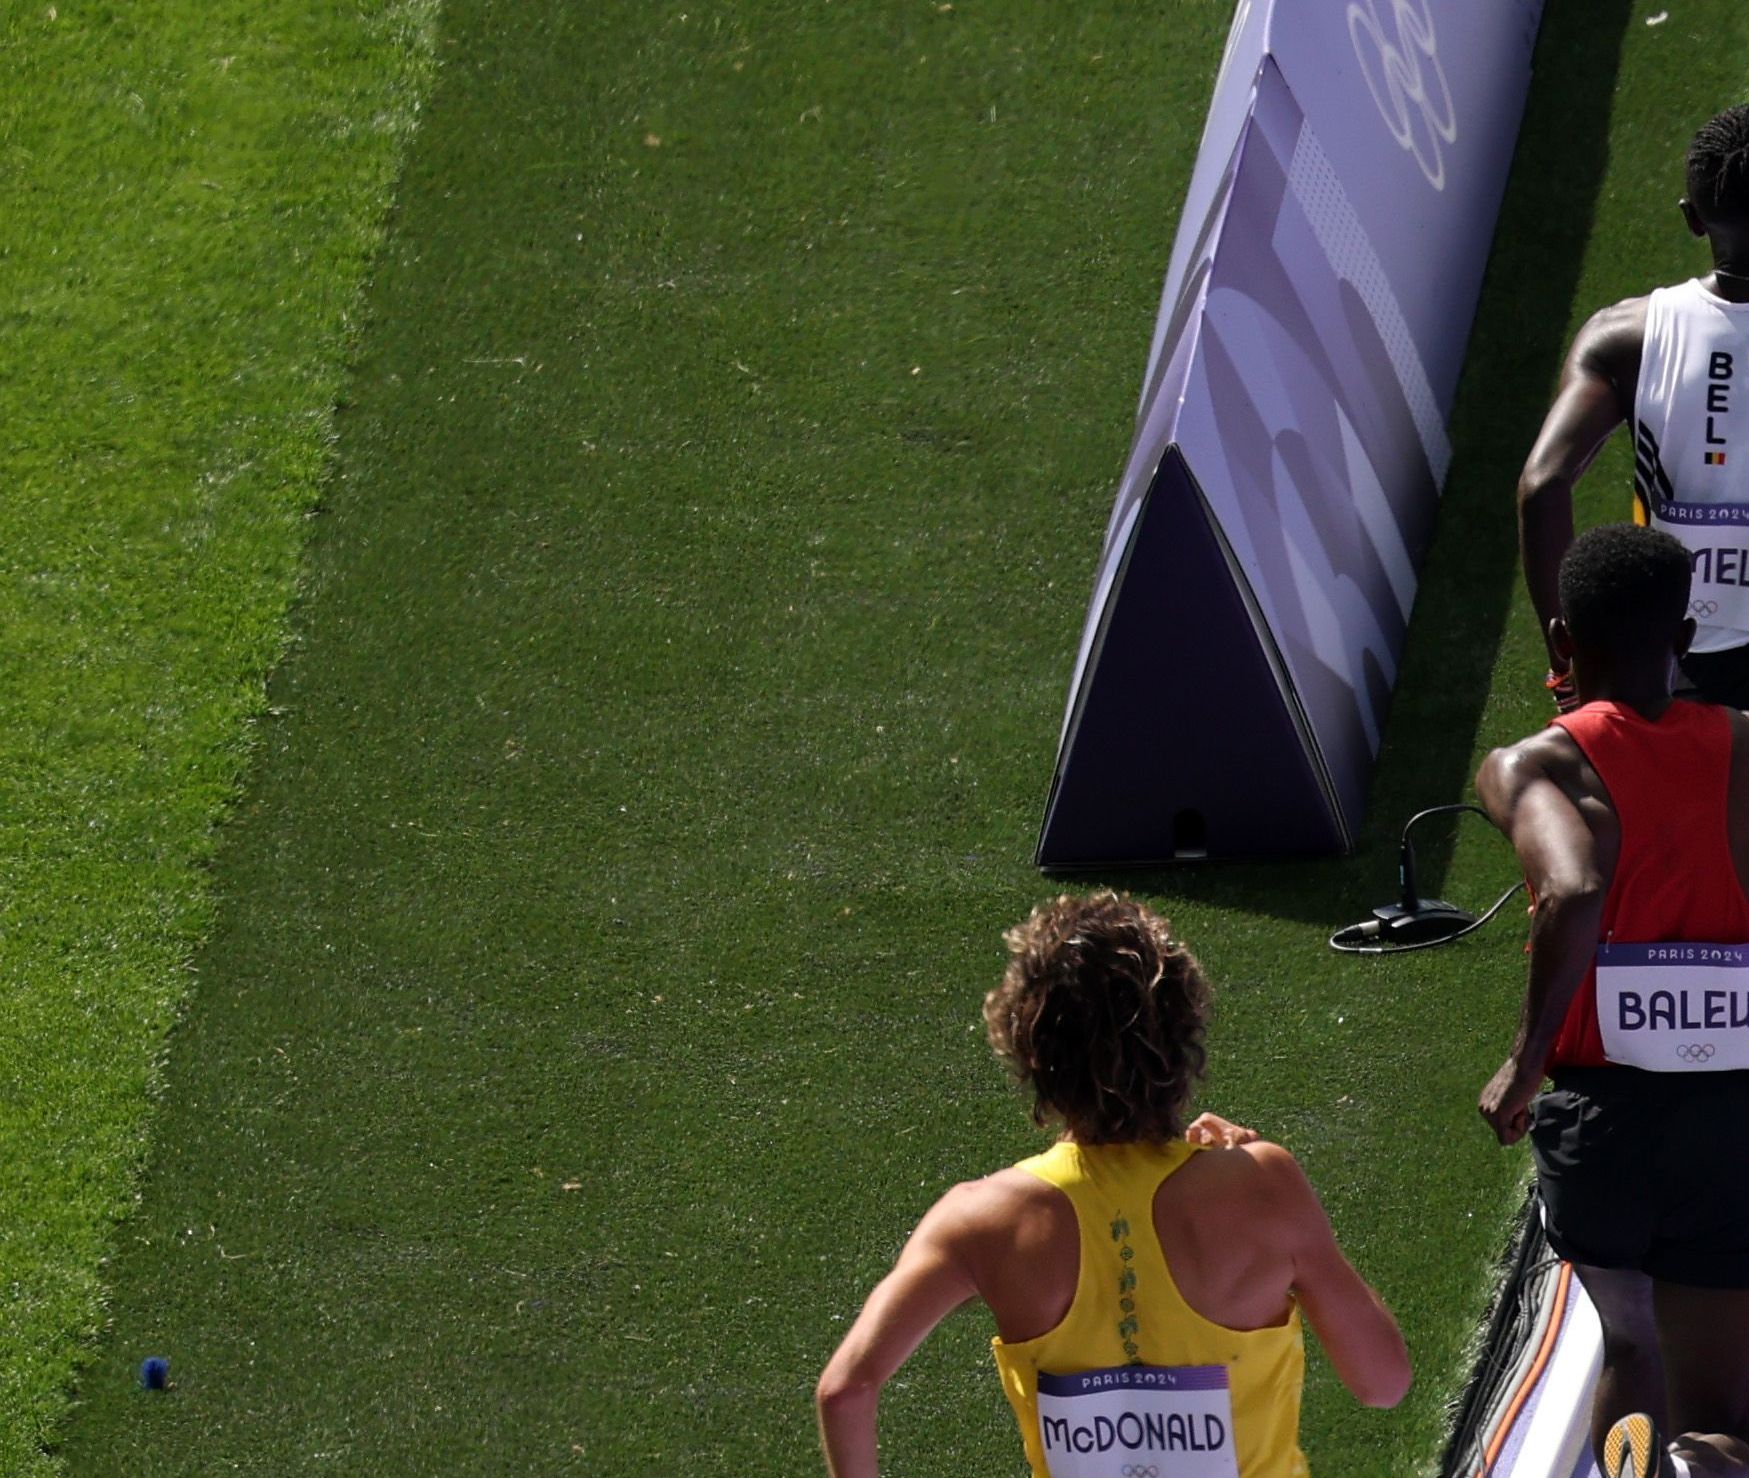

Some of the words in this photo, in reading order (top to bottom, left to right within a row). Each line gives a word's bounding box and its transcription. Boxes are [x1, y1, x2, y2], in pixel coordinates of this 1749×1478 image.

[1705, 351, 1734, 445] BEL
[1660, 503, 1704, 520] PARIS
[1648, 949, 1695, 960] PARIS
[1700, 949, 1743, 961] 2024
[1082, 1372, 1130, 1388] PARIS
[1134, 1373, 1177, 1385] 2024
[1042, 1411, 1225, 1454] McDONALD
